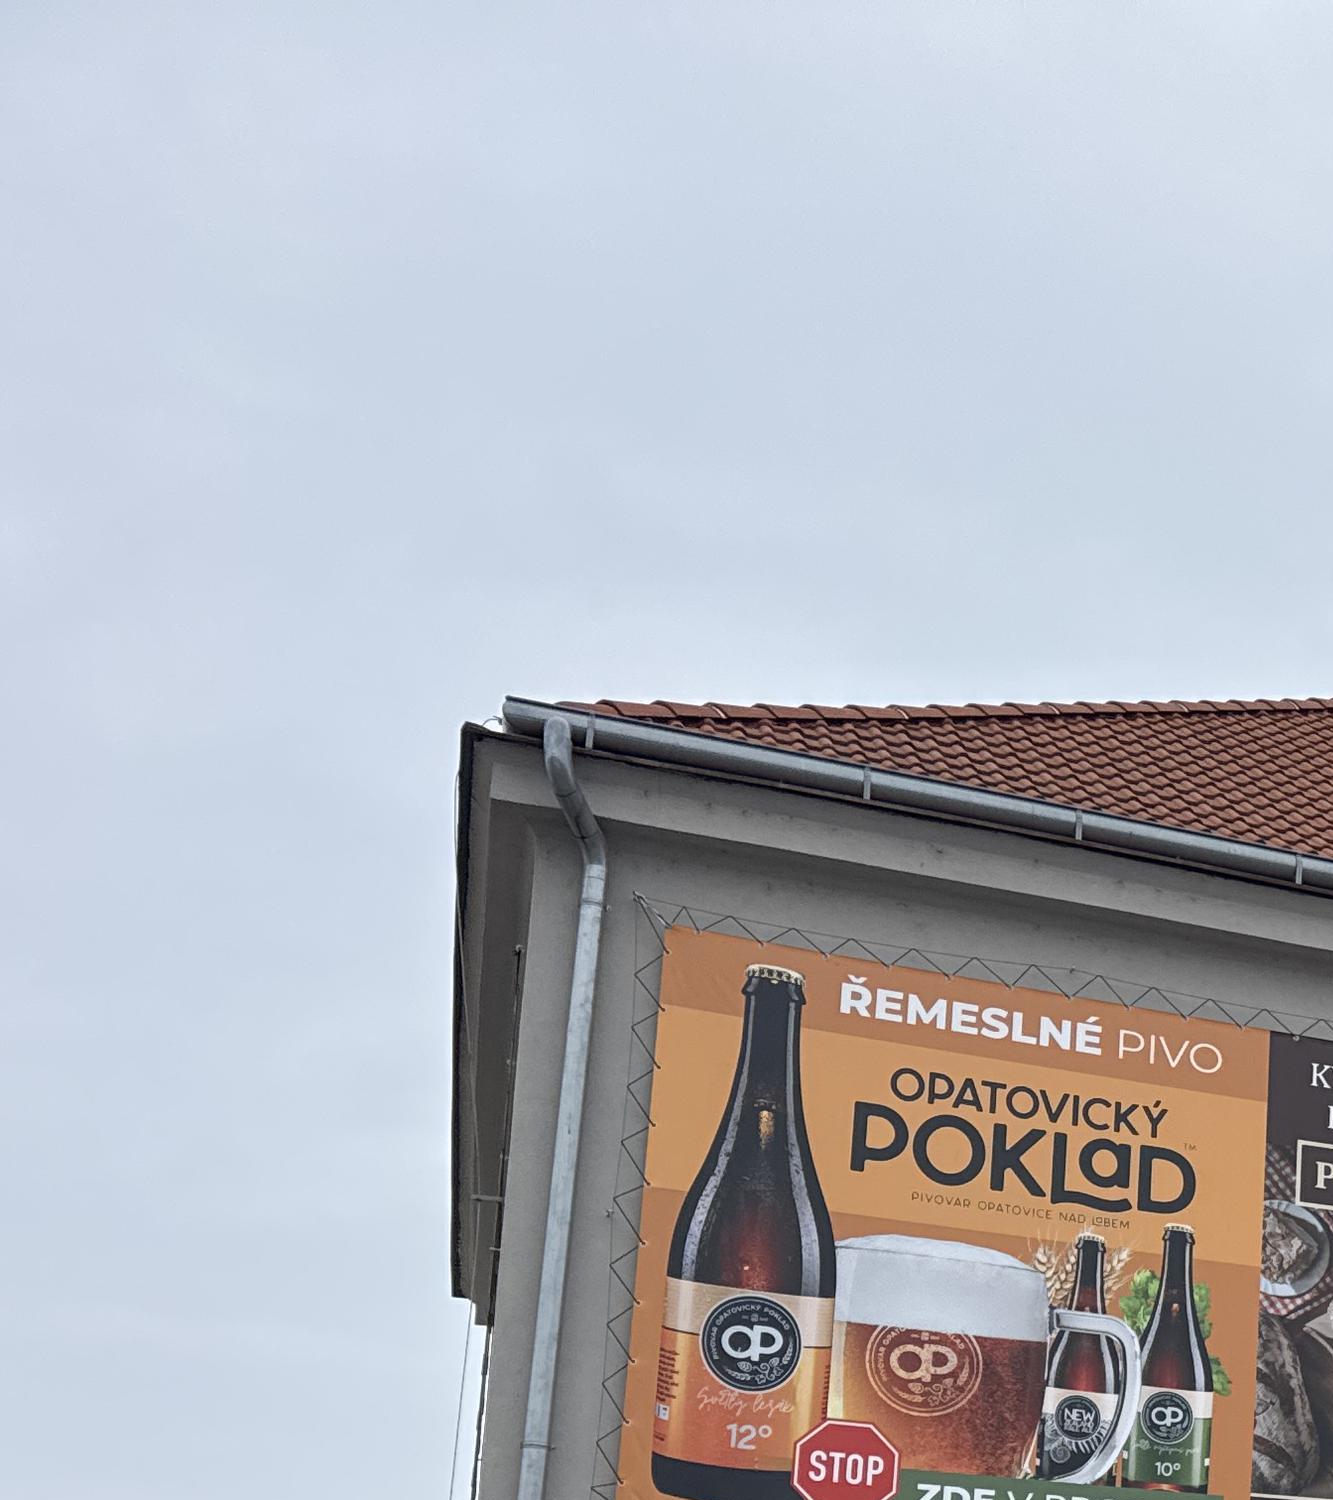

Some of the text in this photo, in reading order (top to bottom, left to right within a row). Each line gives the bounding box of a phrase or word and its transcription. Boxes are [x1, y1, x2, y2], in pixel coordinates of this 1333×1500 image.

[840, 975, 1223, 1074] ŘEMESLNÉ PIVO
[890, 1067, 1168, 1138] OPATOVICKÝ
[911, 1191, 971, 1208] PIVOVAR
[978, 1200, 1051, 1219] OPATOVICE
[1059, 1212, 1086, 1224] NAD
[1064, 1407, 1096, 1423] NEW
[809, 1449, 885, 1487] STOP
